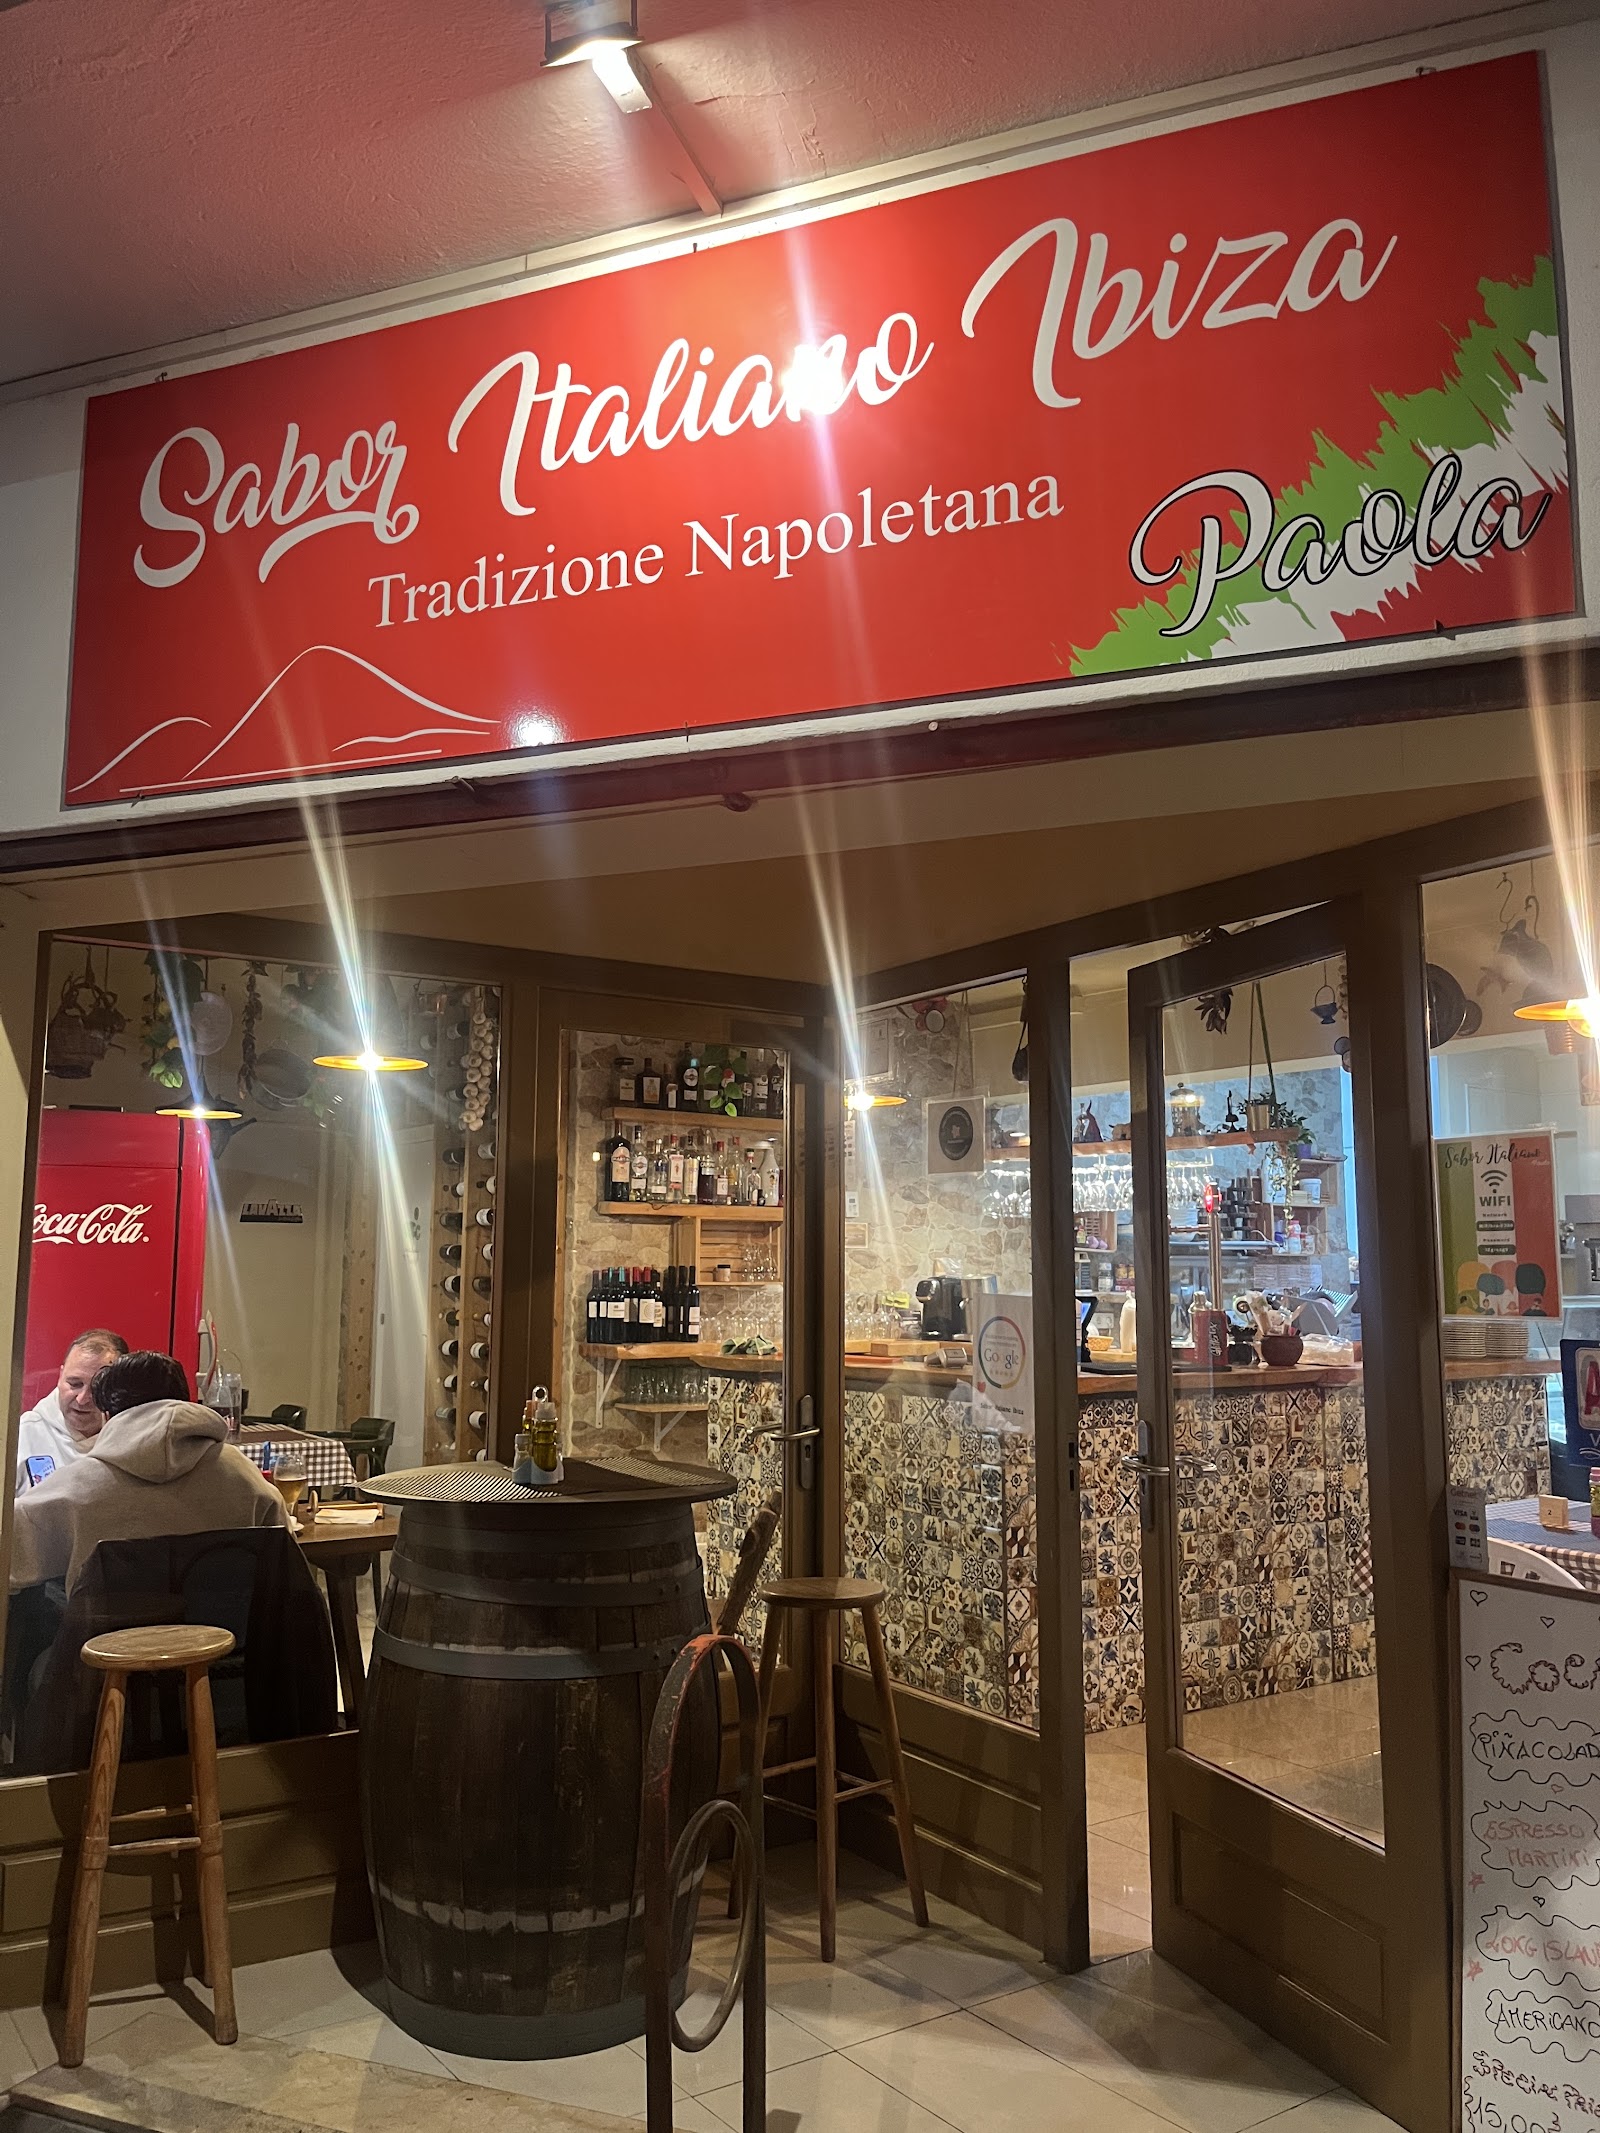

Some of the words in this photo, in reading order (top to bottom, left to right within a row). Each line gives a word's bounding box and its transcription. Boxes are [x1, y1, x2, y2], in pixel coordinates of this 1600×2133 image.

[134, 420, 419, 588] Sabor
[449, 312, 935, 516] Italiano
[961, 217, 1398, 408] Ibiza
[369, 544, 664, 628] Tradizione
[683, 473, 1064, 580] Napoletana
[1128, 453, 1553, 638] Paola
[1444, 1146, 1484, 1169] Sabor
[1480, 1195, 1511, 1207] WIFI
